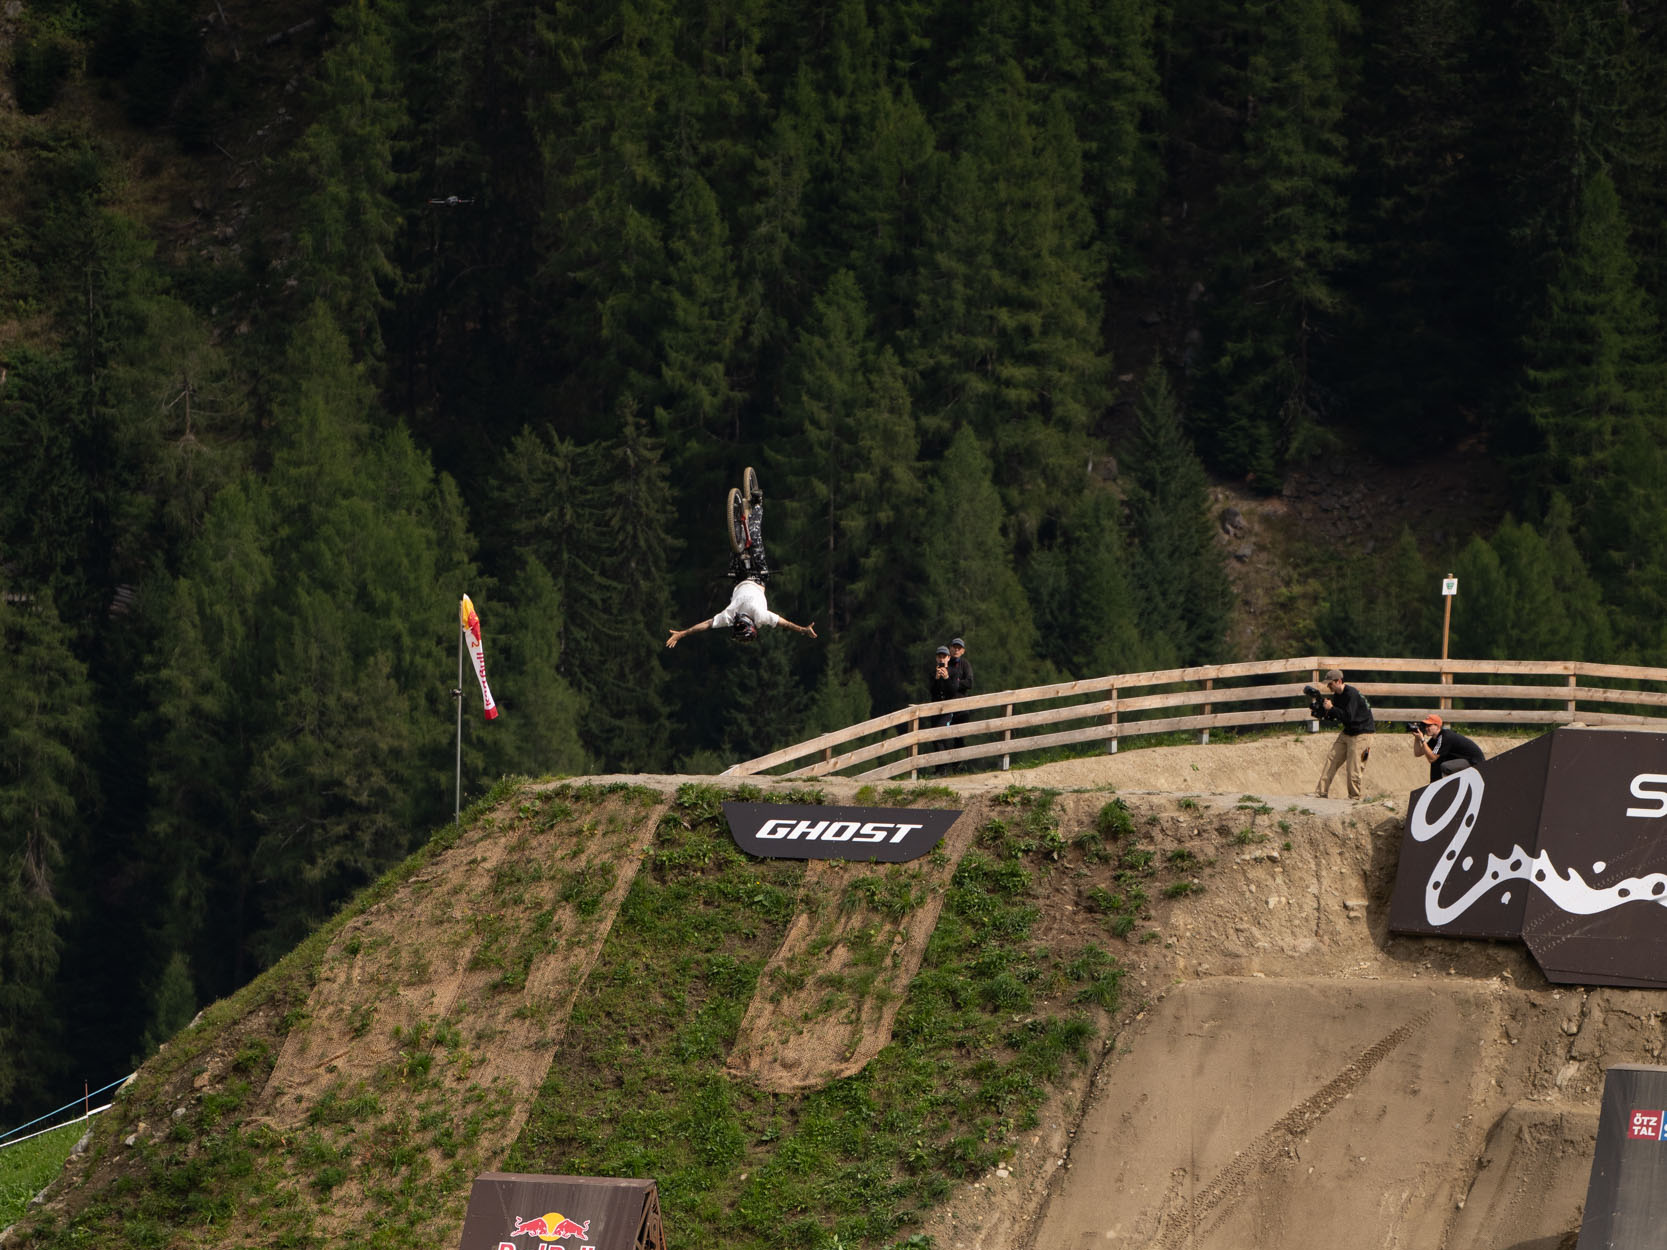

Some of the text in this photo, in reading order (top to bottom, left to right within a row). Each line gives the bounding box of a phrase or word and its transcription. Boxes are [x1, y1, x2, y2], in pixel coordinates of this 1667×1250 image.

[755, 819, 923, 844] GHOST
[1633, 1113, 1658, 1126] ÖTZ
[1632, 1126, 1656, 1136] TAL
